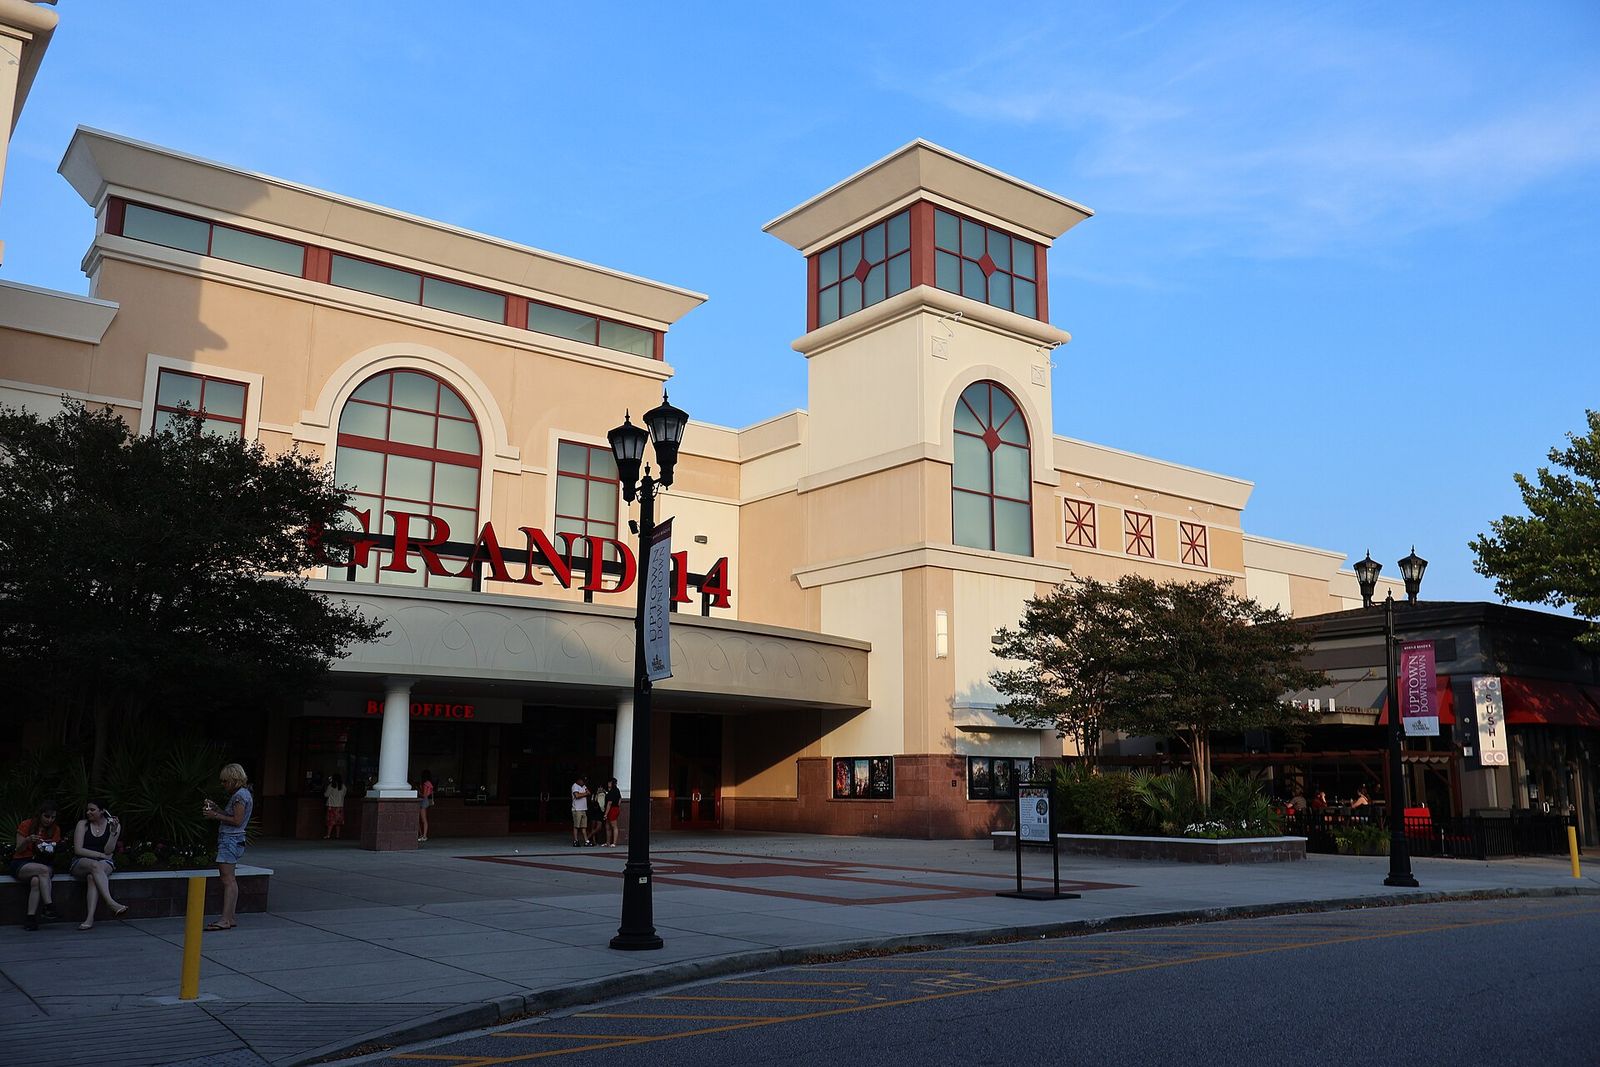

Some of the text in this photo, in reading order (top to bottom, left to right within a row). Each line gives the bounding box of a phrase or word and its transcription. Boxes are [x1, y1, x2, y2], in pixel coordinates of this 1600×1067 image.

[307, 504, 731, 608] GRAND 14
[650, 548, 659, 642] UPTOWN
[657, 547, 665, 640] DOWNTOWN
[410, 702, 475, 720] OFFICE
[1409, 655, 1420, 714] UPTOWN
[1419, 654, 1429, 713] DOWNTOWN
[1485, 694, 1498, 749] SUSHI
[1483, 751, 1506, 764] CO
